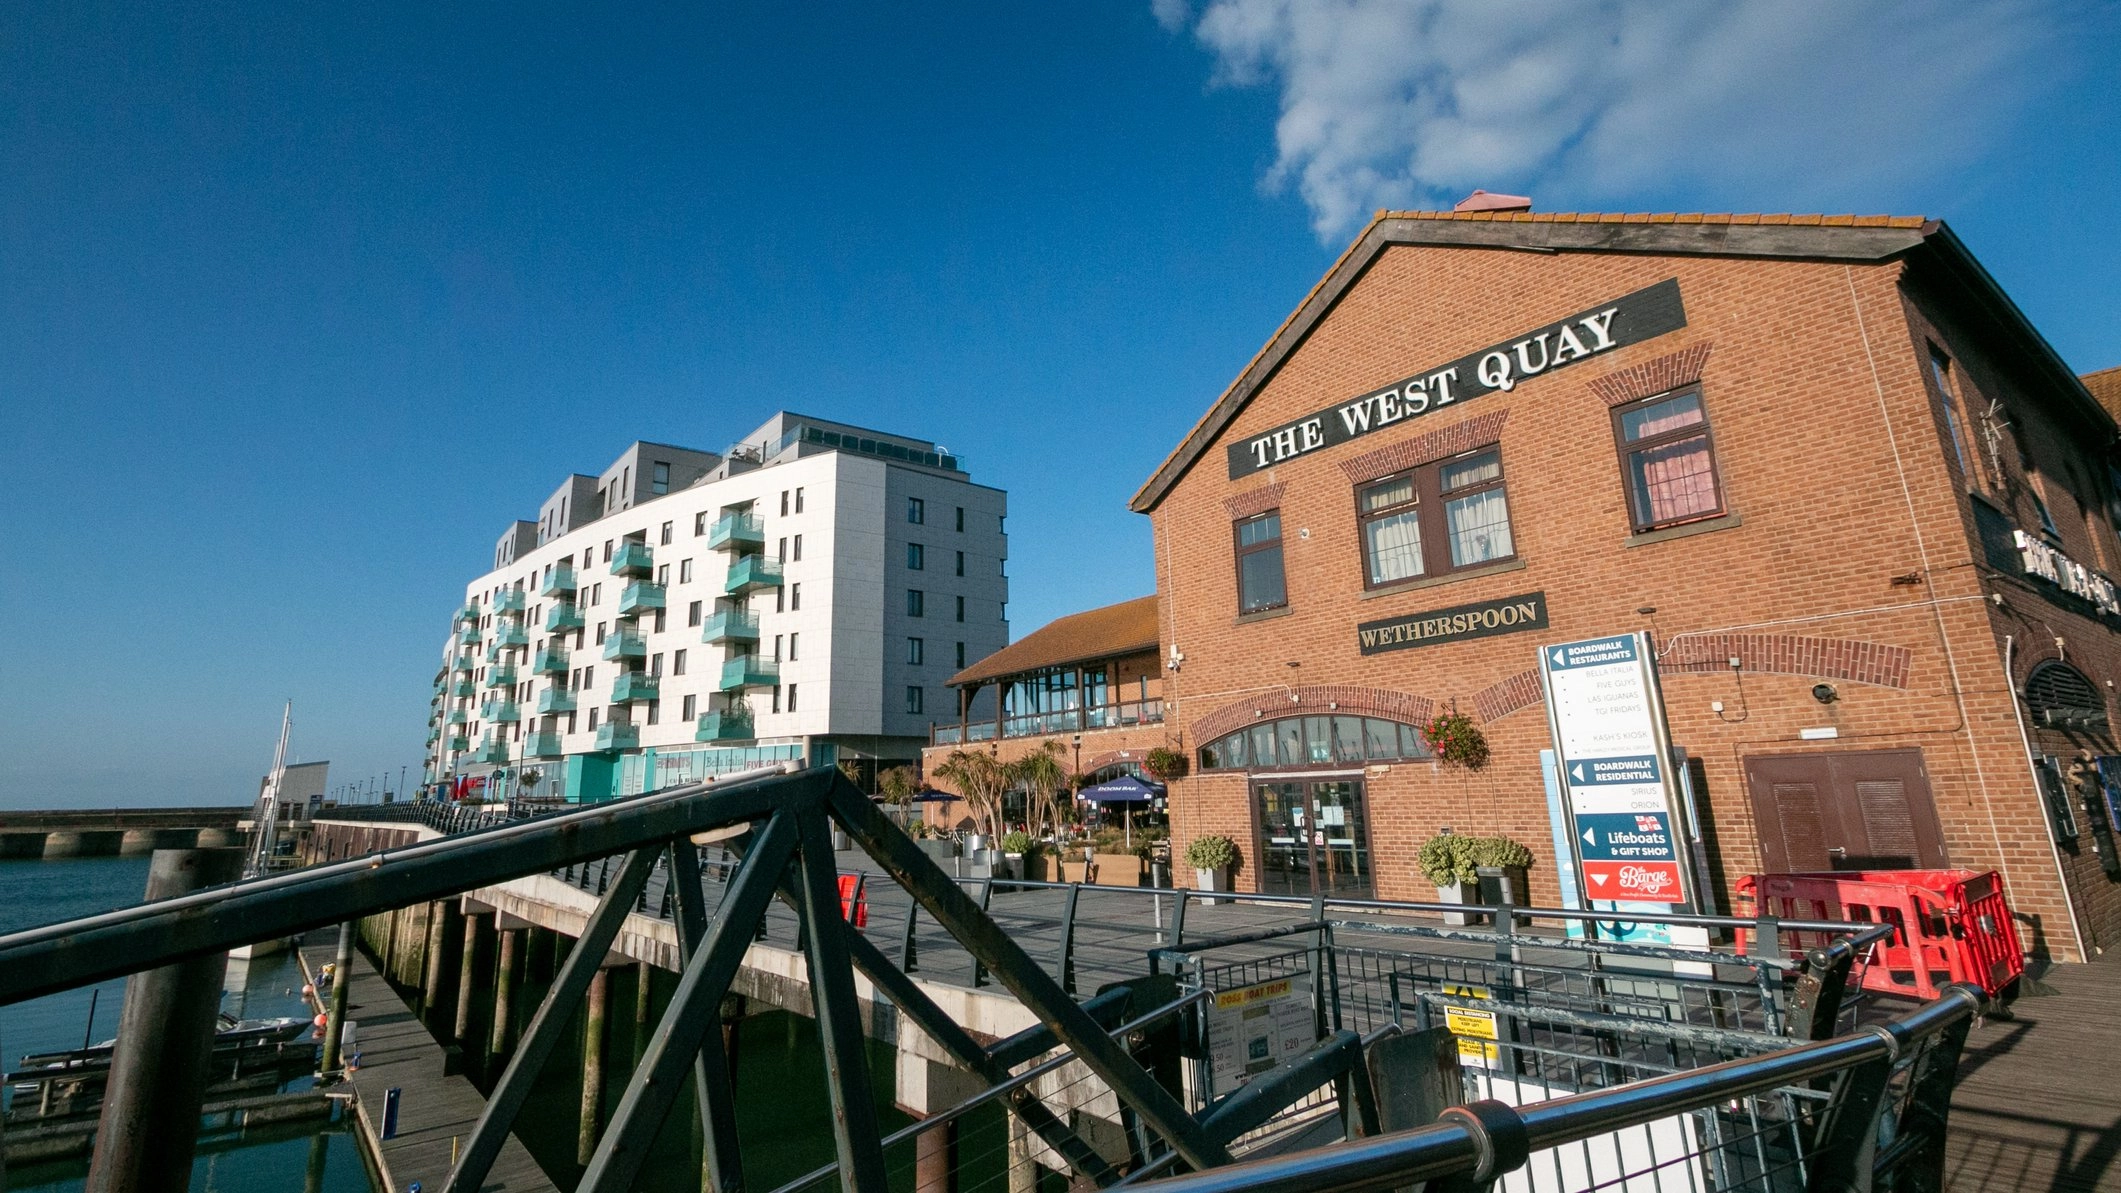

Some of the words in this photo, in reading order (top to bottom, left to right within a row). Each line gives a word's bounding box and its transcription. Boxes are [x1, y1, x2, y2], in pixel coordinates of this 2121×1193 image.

[1251, 417, 1323, 468] THE
[1339, 366, 1459, 436] WEST
[1477, 307, 1618, 392] QUAY
[1360, 602, 1536, 648] WETHERSPOON
[1568, 641, 1622, 656] BOARDWALK
[1569, 650, 1631, 666] RESTAURANTS
[1586, 668, 1608, 678] BELLA
[1610, 665, 1634, 674] ITALIA
[1596, 680, 1612, 688] FIVE
[1614, 678, 1637, 687] GUYS
[1587, 695, 1601, 703] LAS
[1603, 691, 1639, 702] IGUANAS
[1610, 704, 1641, 713] FRIDAYS
[1623, 731, 1648, 739] KIOSK
[747, 760, 764, 769] FIVE
[1593, 760, 1651, 771] BOARDWALK
[1595, 770, 1654, 782] RESIDENTIAL
[1631, 787, 1657, 796] SIRIUS
[1631, 801, 1659, 809] ORION
[1607, 832, 1666, 845] Lifeboats
[1611, 848, 1618, 856] &
[1619, 847, 1640, 856] GIFT
[1641, 847, 1669, 856] SHOP
[1619, 865, 1667, 894] Barge
[1266, 982, 1287, 994] TRIPS
